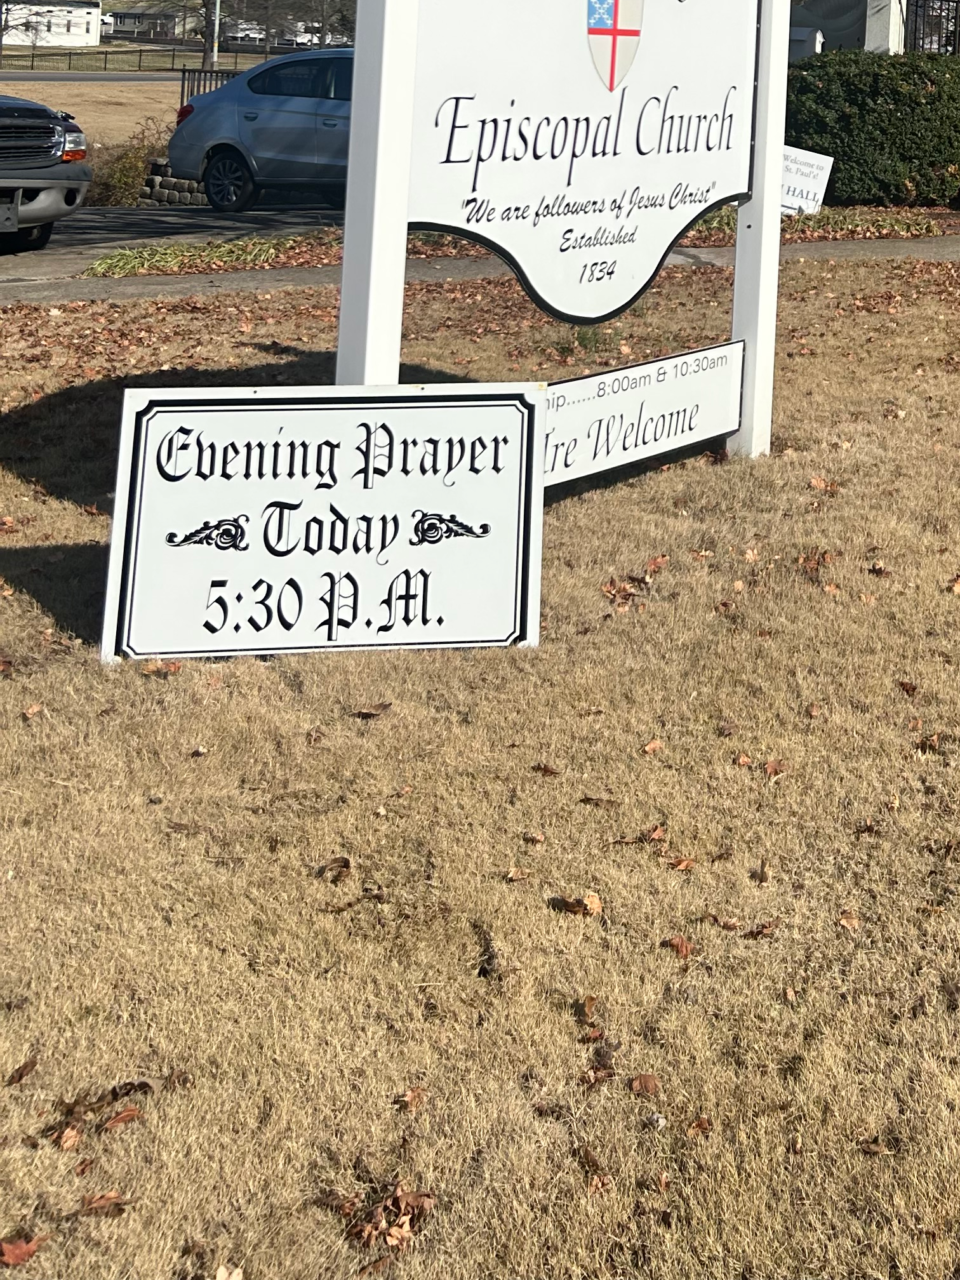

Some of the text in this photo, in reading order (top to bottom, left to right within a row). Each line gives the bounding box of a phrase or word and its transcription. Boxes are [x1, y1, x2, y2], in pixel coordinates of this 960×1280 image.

[434, 85, 737, 192] Episcopal Church
[501, 204, 531, 222] are
[533, 194, 606, 227] followers
[610, 190, 627, 219] of
[626, 186, 666, 219] Jesus
[786, 185, 819, 203] HALL
[559, 225, 638, 253] Established
[579, 260, 617, 284] 1834
[656, 367, 668, 383] &
[673, 353, 728, 380] 10:30am
[587, 399, 700, 461] Welcome
[155, 422, 510, 490] Evening Prayer
[261, 499, 400, 564] Today
[201, 569, 445, 641] 5:30 P.M.
